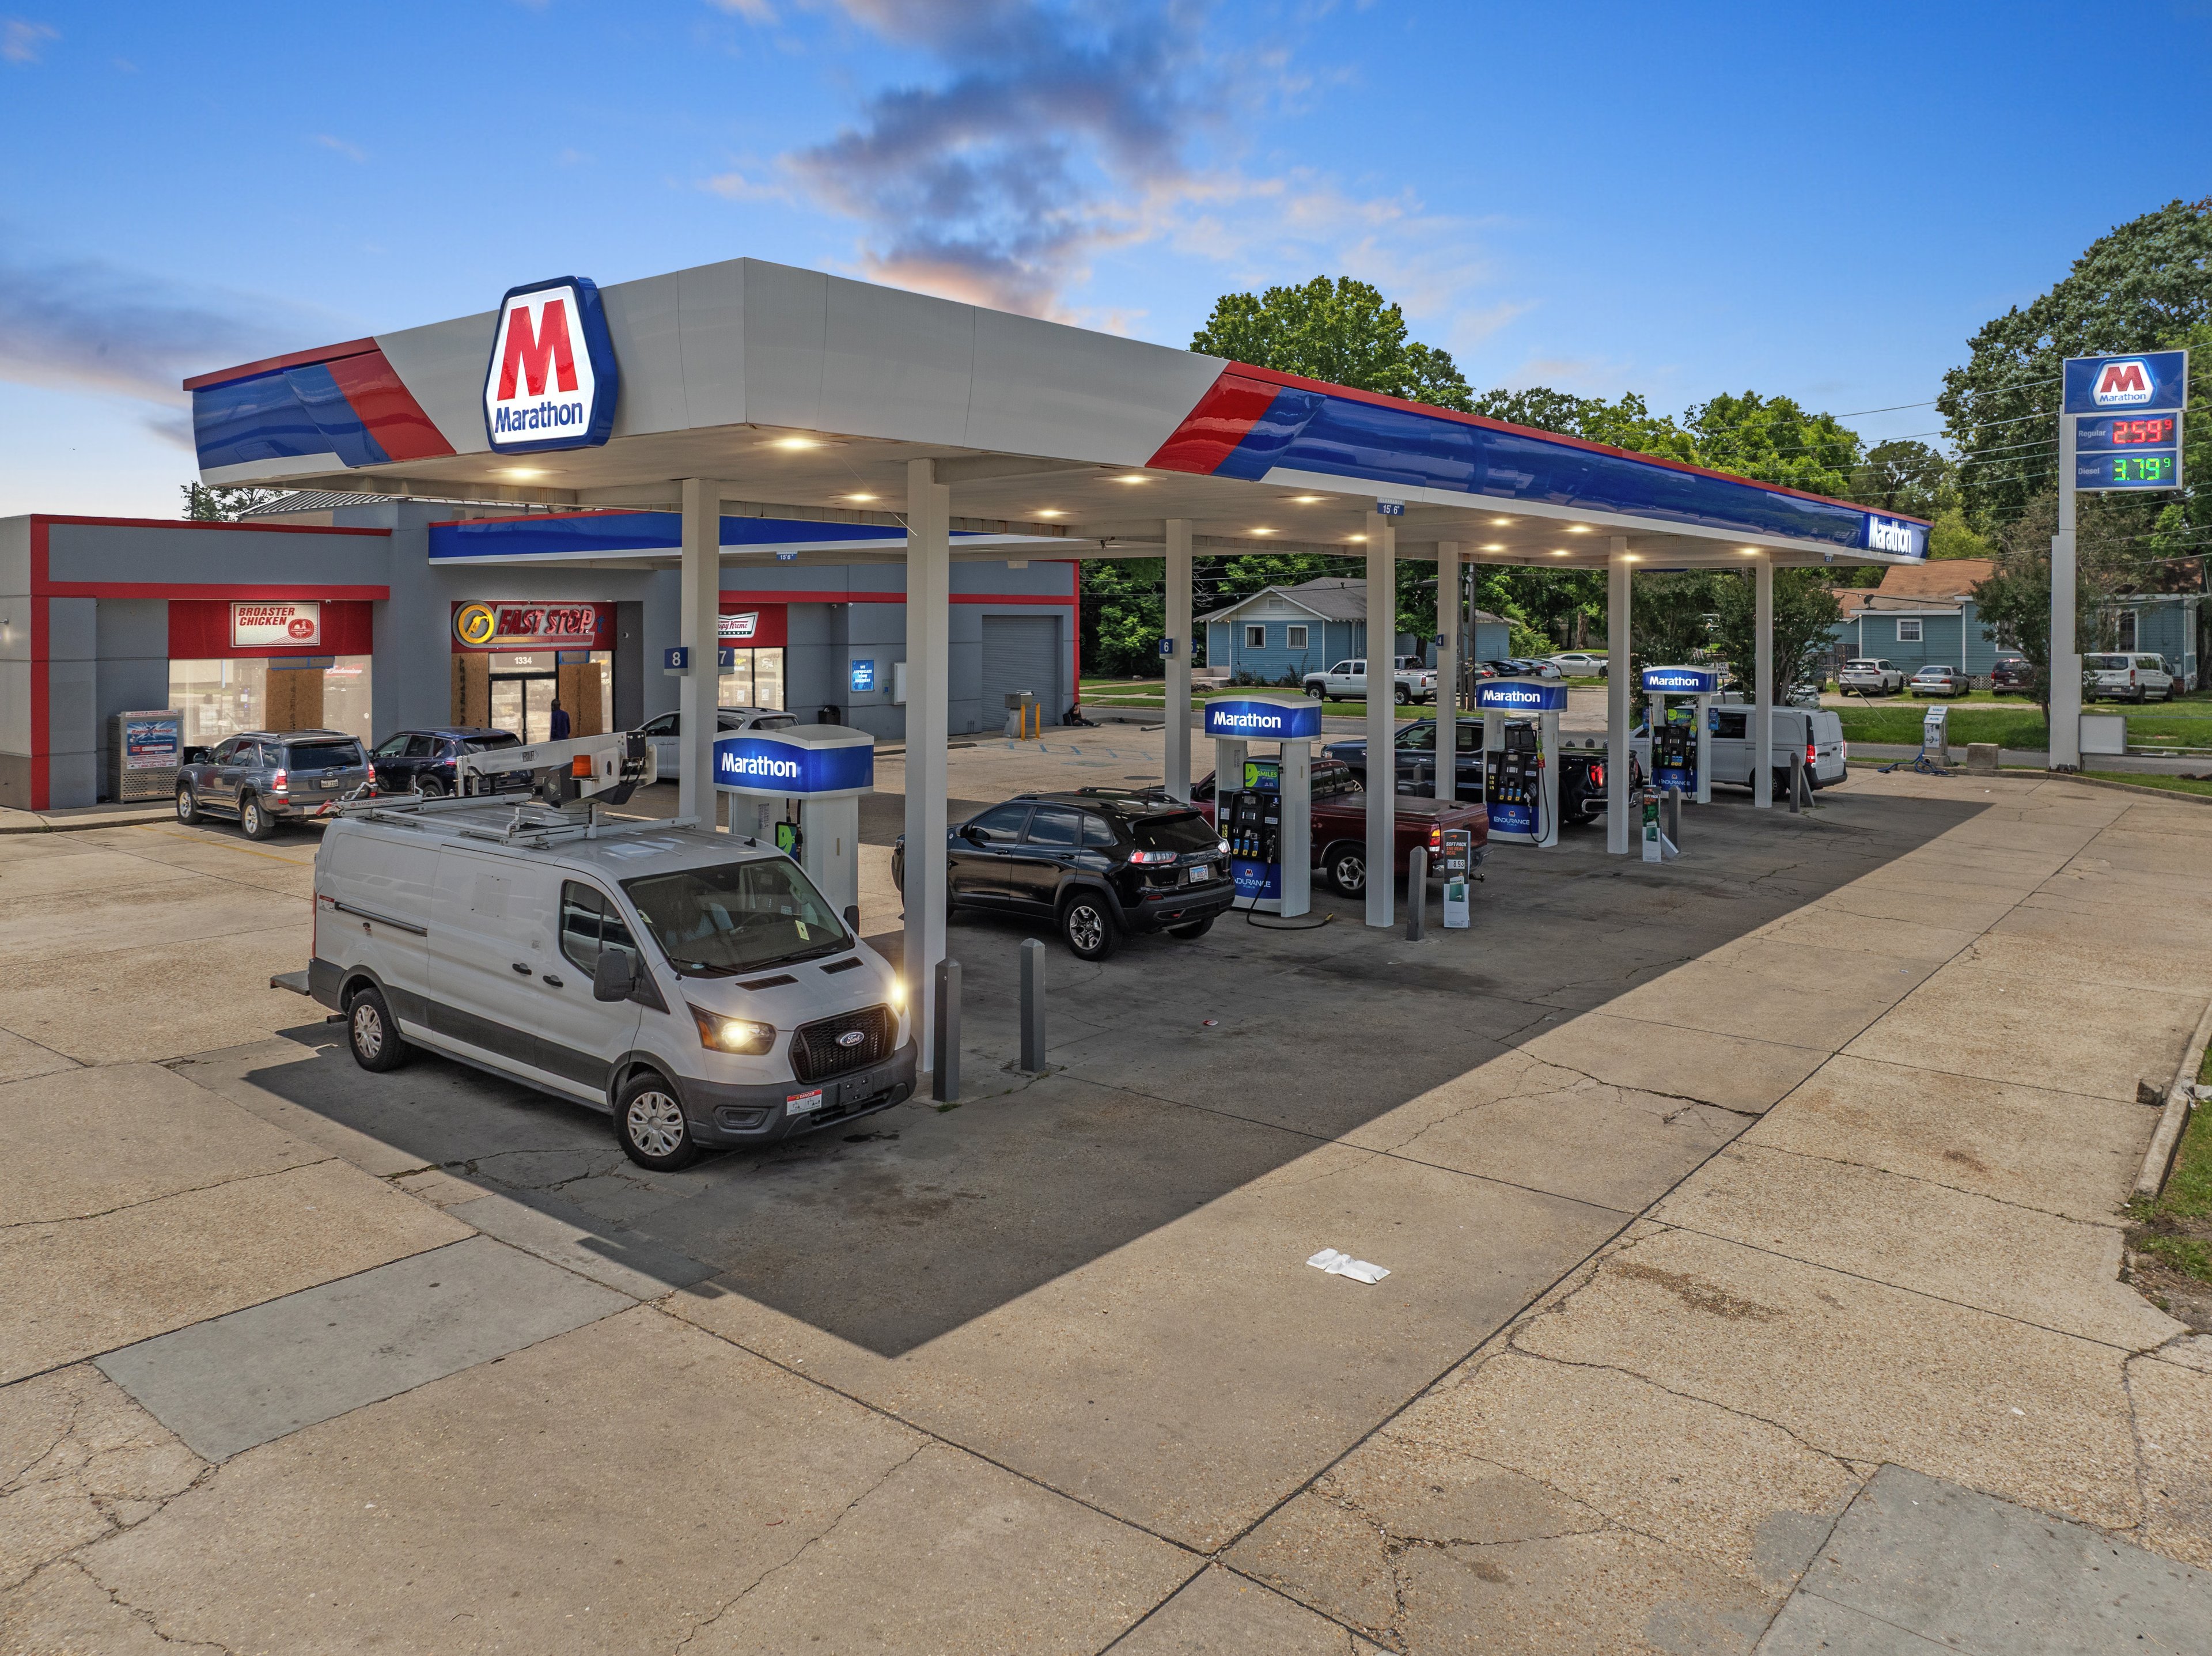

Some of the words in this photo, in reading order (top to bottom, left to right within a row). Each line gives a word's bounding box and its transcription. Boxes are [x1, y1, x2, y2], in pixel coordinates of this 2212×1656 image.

[497, 299, 578, 401] M
[2100, 365, 2145, 393] M
[2099, 393, 2146, 402] Marathon
[495, 401, 583, 433] Marathon
[2078, 430, 2106, 438] Regular
[1869, 516, 1911, 554] Marathon
[238, 607, 295, 616] BROASTER
[240, 616, 287, 626] CHICKEN
[498, 609, 546, 634] FAST
[545, 609, 593, 634] STOP
[729, 621, 748, 629] Kreme
[1438, 636, 1441, 645] 4
[1164, 642, 1169, 652] 6
[672, 651, 681, 666] 8
[719, 650, 727, 664] 7
[1649, 676, 1699, 687] Marathon
[1483, 689, 1540, 703] Marathon
[1213, 711, 1281, 729] Marathon
[721, 752, 797, 778] Marathon
[1494, 816, 1530, 825] ENDURANCE
[1234, 877, 1271, 888] NDURANCE
[847, 1034, 860, 1044] Ford
